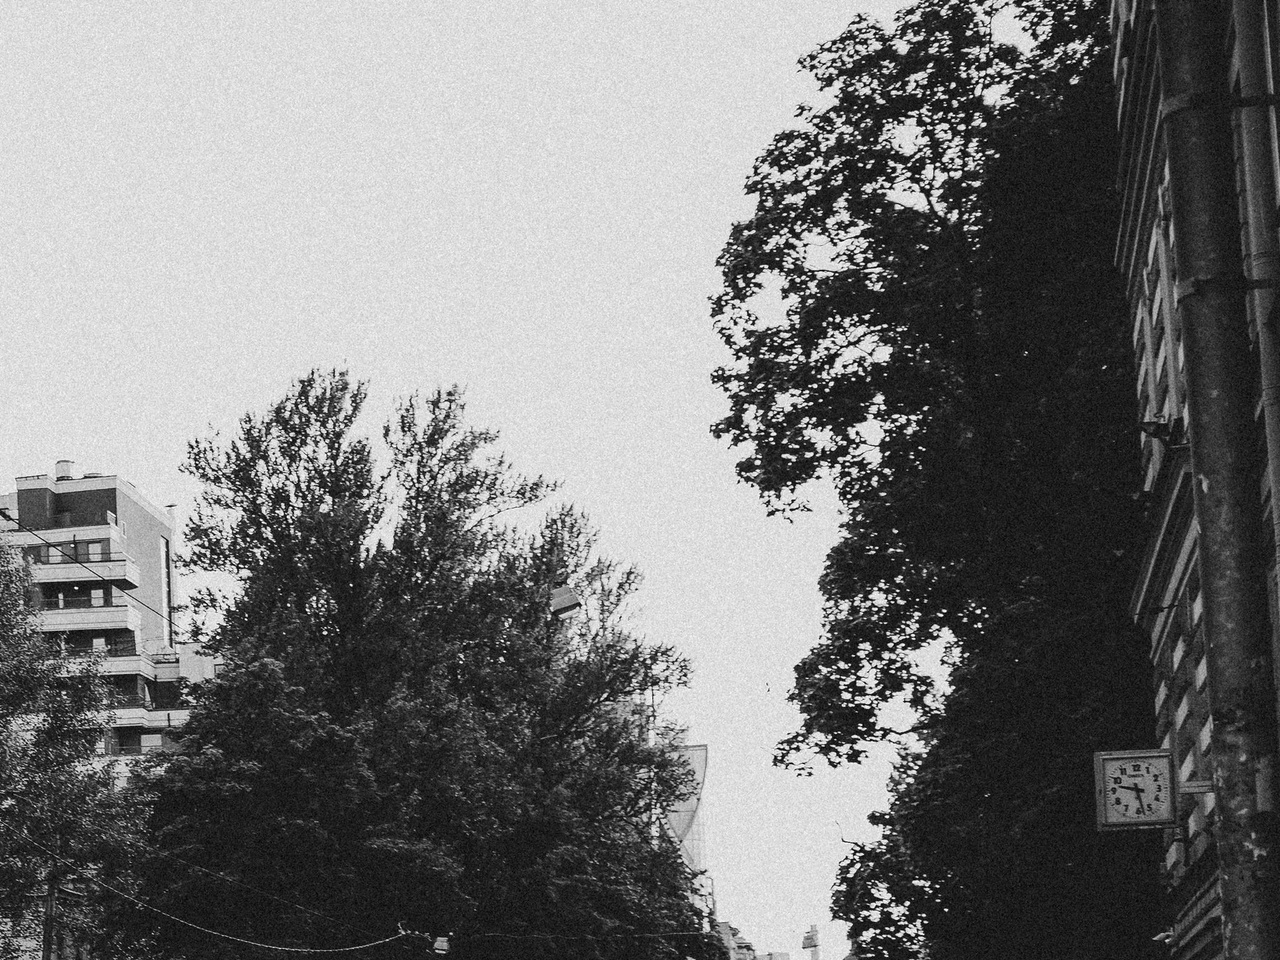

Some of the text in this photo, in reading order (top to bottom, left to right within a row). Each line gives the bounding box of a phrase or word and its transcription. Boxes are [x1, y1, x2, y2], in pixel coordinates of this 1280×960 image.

[1131, 764, 1141, 772] 12
[1114, 777, 1122, 785] 10
[1153, 774, 1159, 783] 2
[1111, 787, 1117, 795] 9
[1156, 785, 1161, 793] 3
[1115, 797, 1121, 806] 8
[1123, 804, 1129, 812] 7
[1135, 807, 1141, 816] 6
[1147, 804, 1152, 812] 5
